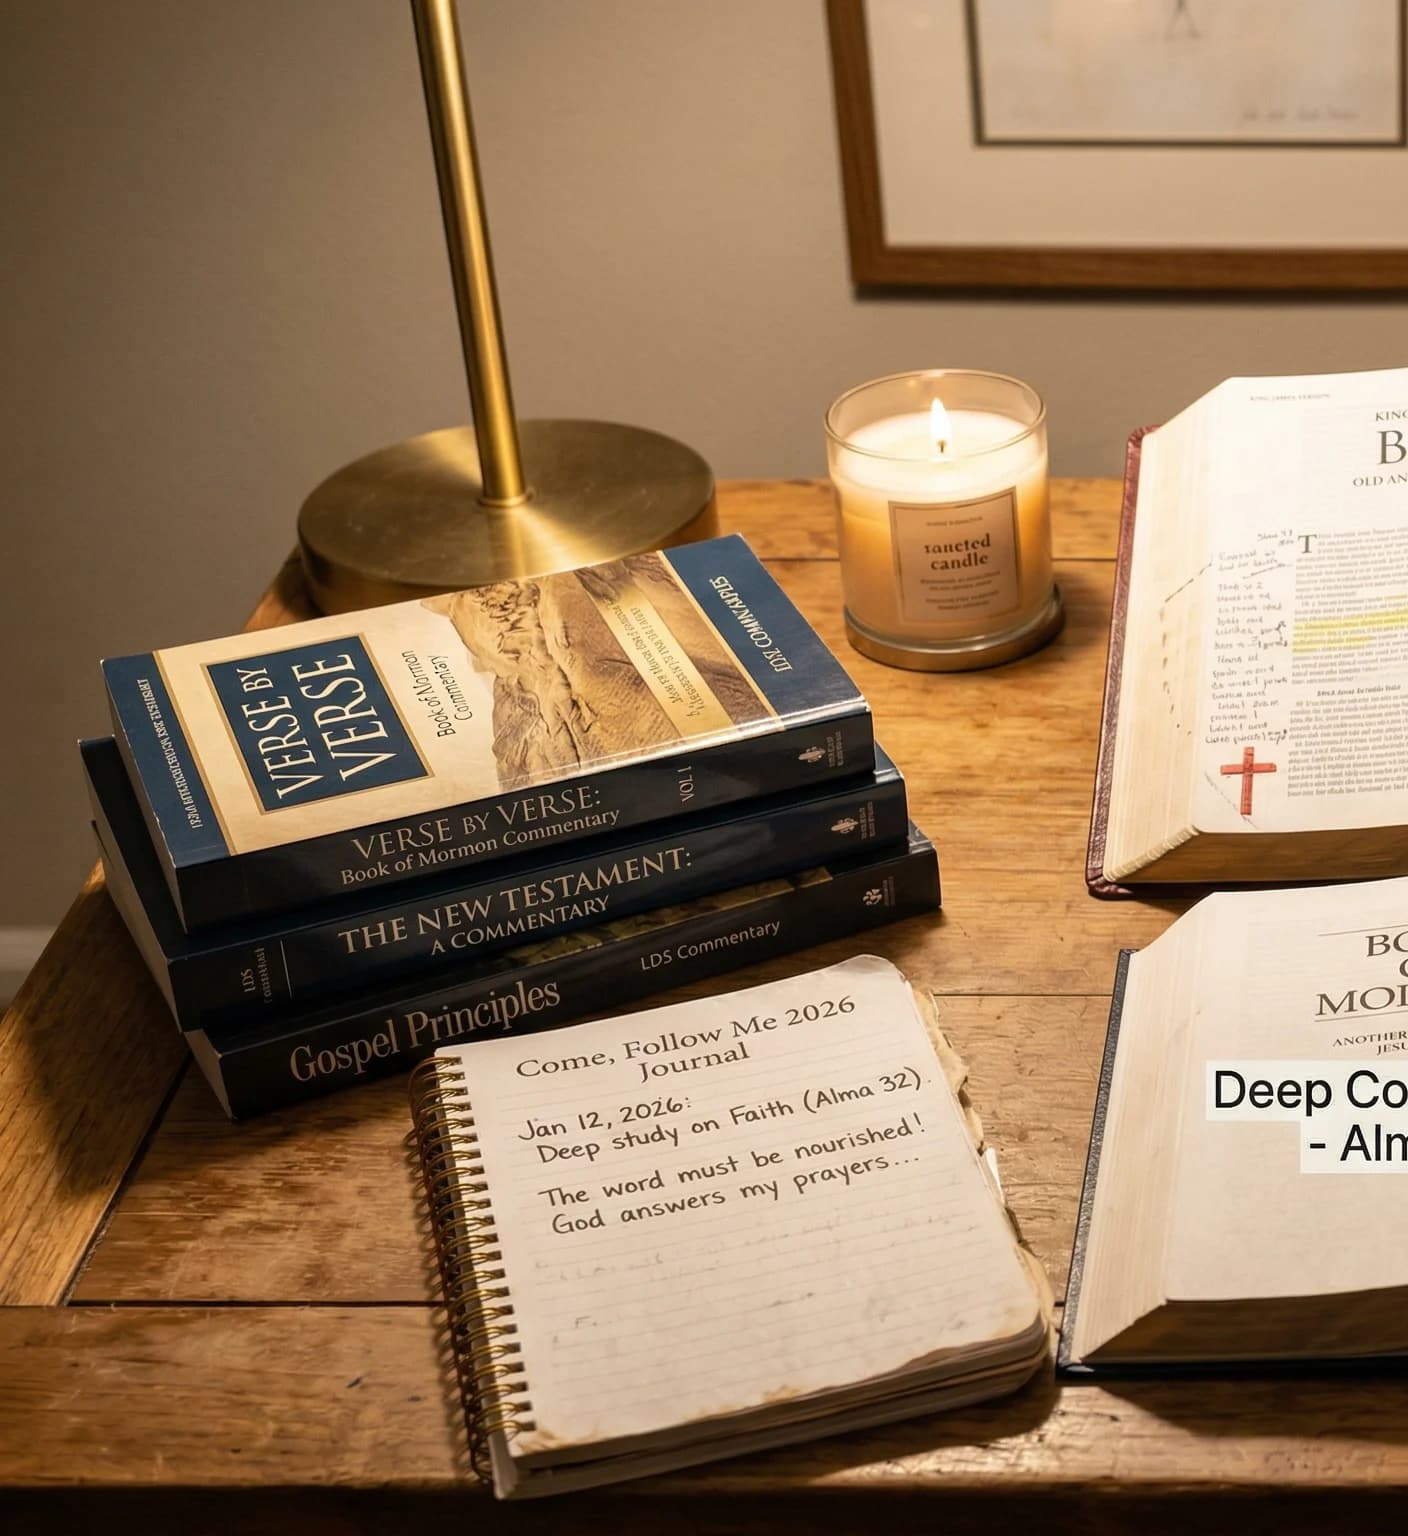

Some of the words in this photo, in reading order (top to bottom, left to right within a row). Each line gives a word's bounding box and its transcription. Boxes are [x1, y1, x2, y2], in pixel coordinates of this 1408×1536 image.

[1353, 475, 1384, 488] OLD
[236, 667, 274, 694] BY
[240, 695, 325, 799] VERSE
[292, 653, 397, 782] VERSE
[428, 707, 456, 738] Book
[679, 774, 696, 802] VOL
[341, 862, 391, 887] Book
[394, 854, 416, 873] of
[418, 836, 498, 868] Mormon
[502, 809, 621, 847] Commentary
[351, 817, 453, 860] VERSE
[463, 811, 491, 836] BY
[495, 786, 601, 828] VERSE:
[337, 917, 408, 955] THE
[416, 895, 495, 936] NEW
[498, 846, 692, 914] TESTAMENT:
[430, 938, 449, 956] A
[450, 895, 611, 951] COMMENTARY
[639, 953, 673, 972] LDS
[676, 920, 782, 961] Commentary
[289, 1018, 400, 1083] Gospel
[405, 980, 562, 1047] Principles
[516, 1047, 615, 1079] Come,
[623, 1025, 723, 1060] Follow
[731, 1015, 779, 1039] Me
[785, 994, 856, 1027] 2026
[638, 1041, 752, 1083] Journal
[1332, 1030, 1408, 1048] ANOTHER
[518, 1117, 568, 1142] Jan
[577, 1111, 613, 1132] 12,
[619, 1096, 692, 1125] 2026:
[537, 1141, 601, 1164] Deep
[611, 1126, 679, 1153] study
[691, 1117, 720, 1135] on
[729, 1098, 794, 1128] Faith
[802, 1083, 875, 1115] (Alma
[538, 1186, 591, 1208] The
[602, 1169, 666, 1200] word
[677, 1156, 741, 1185] must
[751, 1150, 784, 1170] be
[794, 1111, 927, 1161] nourished!
[551, 1211, 606, 1236] God
[619, 1189, 727, 1224] answers
[738, 1180, 780, 1203] my
